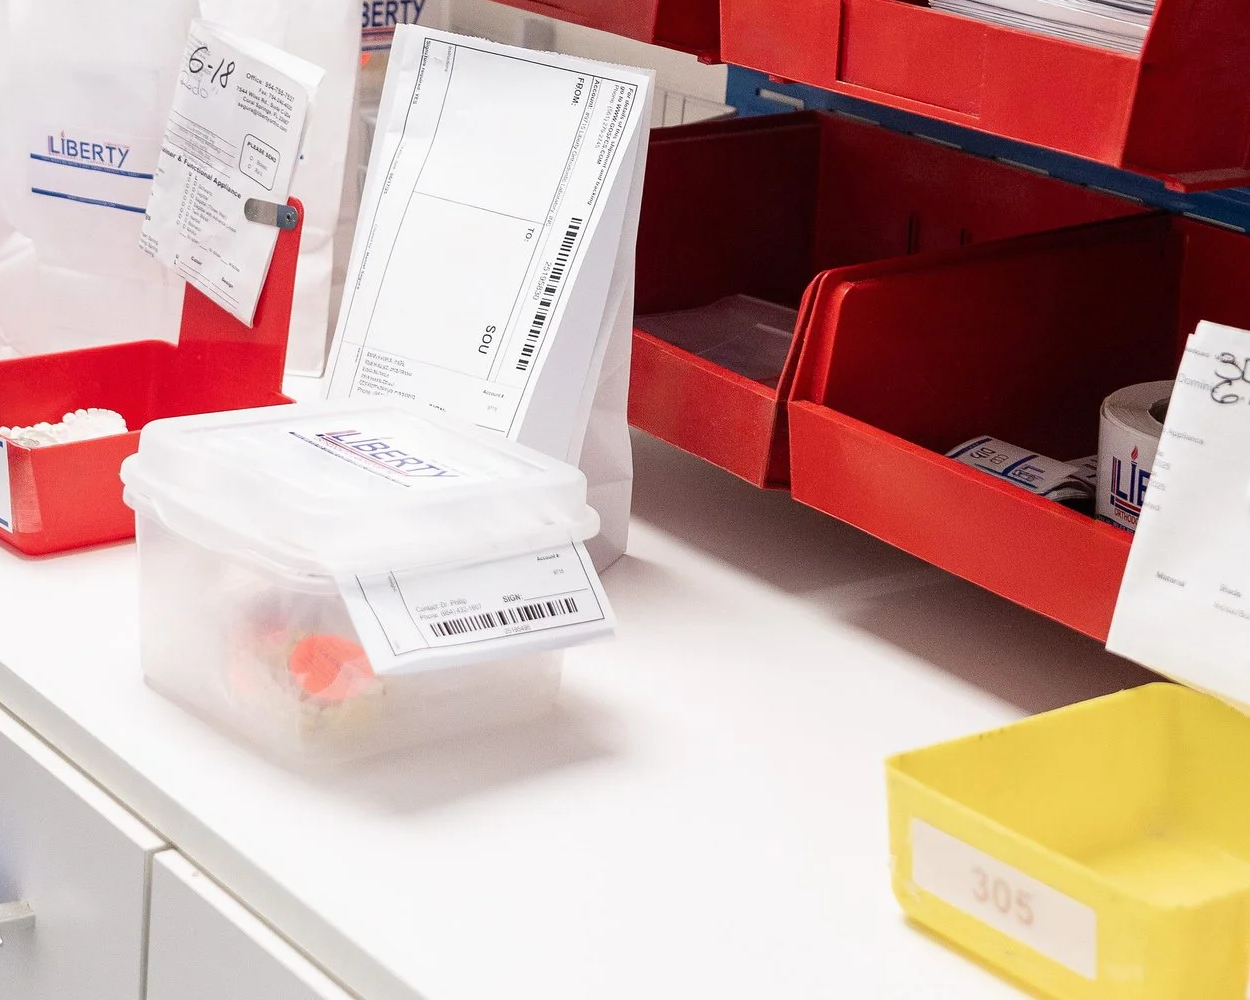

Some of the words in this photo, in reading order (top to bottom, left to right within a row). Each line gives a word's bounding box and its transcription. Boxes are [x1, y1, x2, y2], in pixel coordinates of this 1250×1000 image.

[188, 46, 236, 89] 6-18
[412, 93, 420, 105] YES
[570, 77, 585, 107] FROM:
[619, 85, 626, 95] go
[620, 101, 631, 121] details
[48, 132, 130, 169] LIBERTY
[246, 141, 265, 155] PLEASE
[177, 155, 183, 163] &
[183, 159, 213, 181] Functional
[213, 177, 242, 199] Appliance
[587, 181, 600, 206] tracking
[523, 227, 535, 243] TO:
[478, 324, 497, 355] SOU
[326, 429, 460, 478] LIBERTY
[536, 553, 556, 562] Account
[502, 593, 524, 603] SIGN:
[969, 864, 1036, 926] 305
